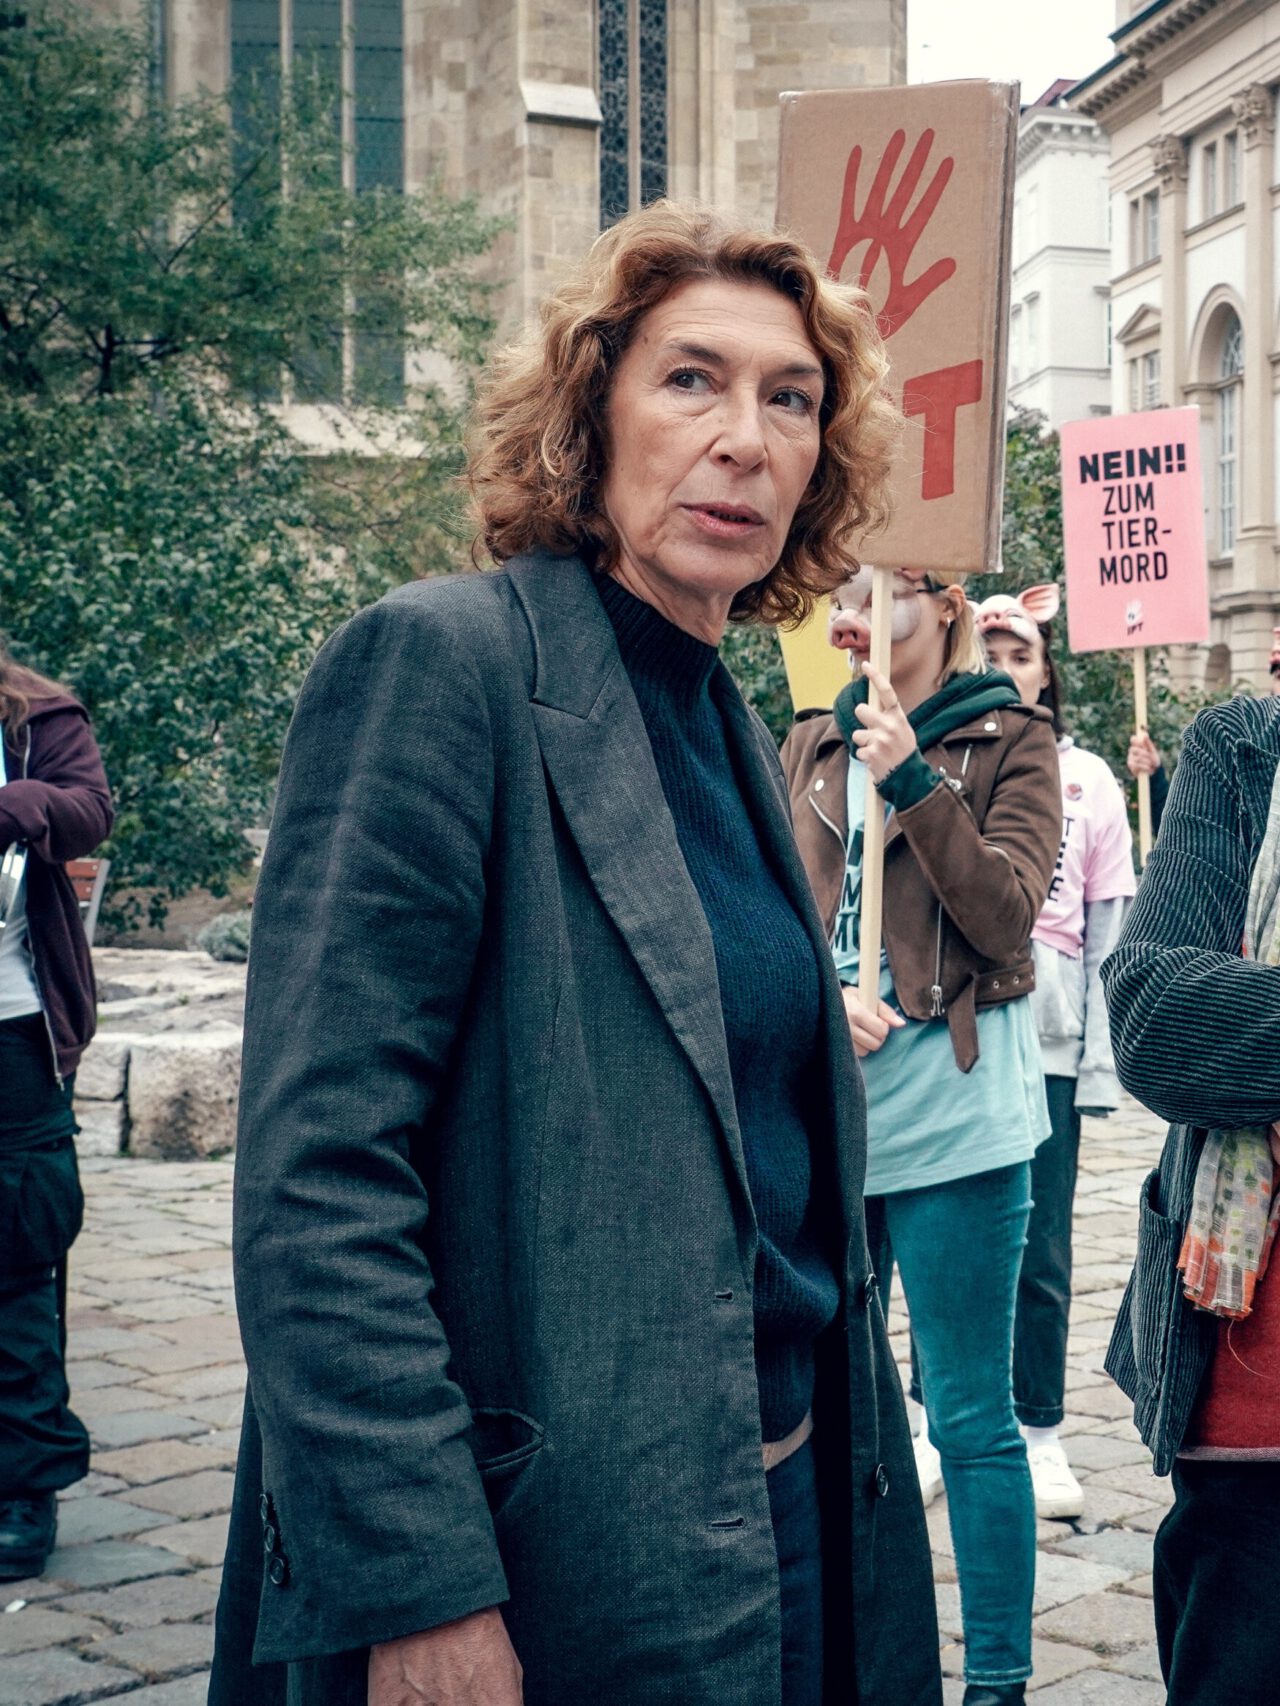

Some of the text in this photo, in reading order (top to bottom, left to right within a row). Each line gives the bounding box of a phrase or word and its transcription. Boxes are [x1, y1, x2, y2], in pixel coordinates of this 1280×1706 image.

[902, 358, 983, 501] T
[1079, 443, 1186, 484] NEIN!!
[1102, 482, 1155, 515] ZUM
[1102, 517, 1172, 550] TIER-
[1100, 551, 1168, 586] MORD
